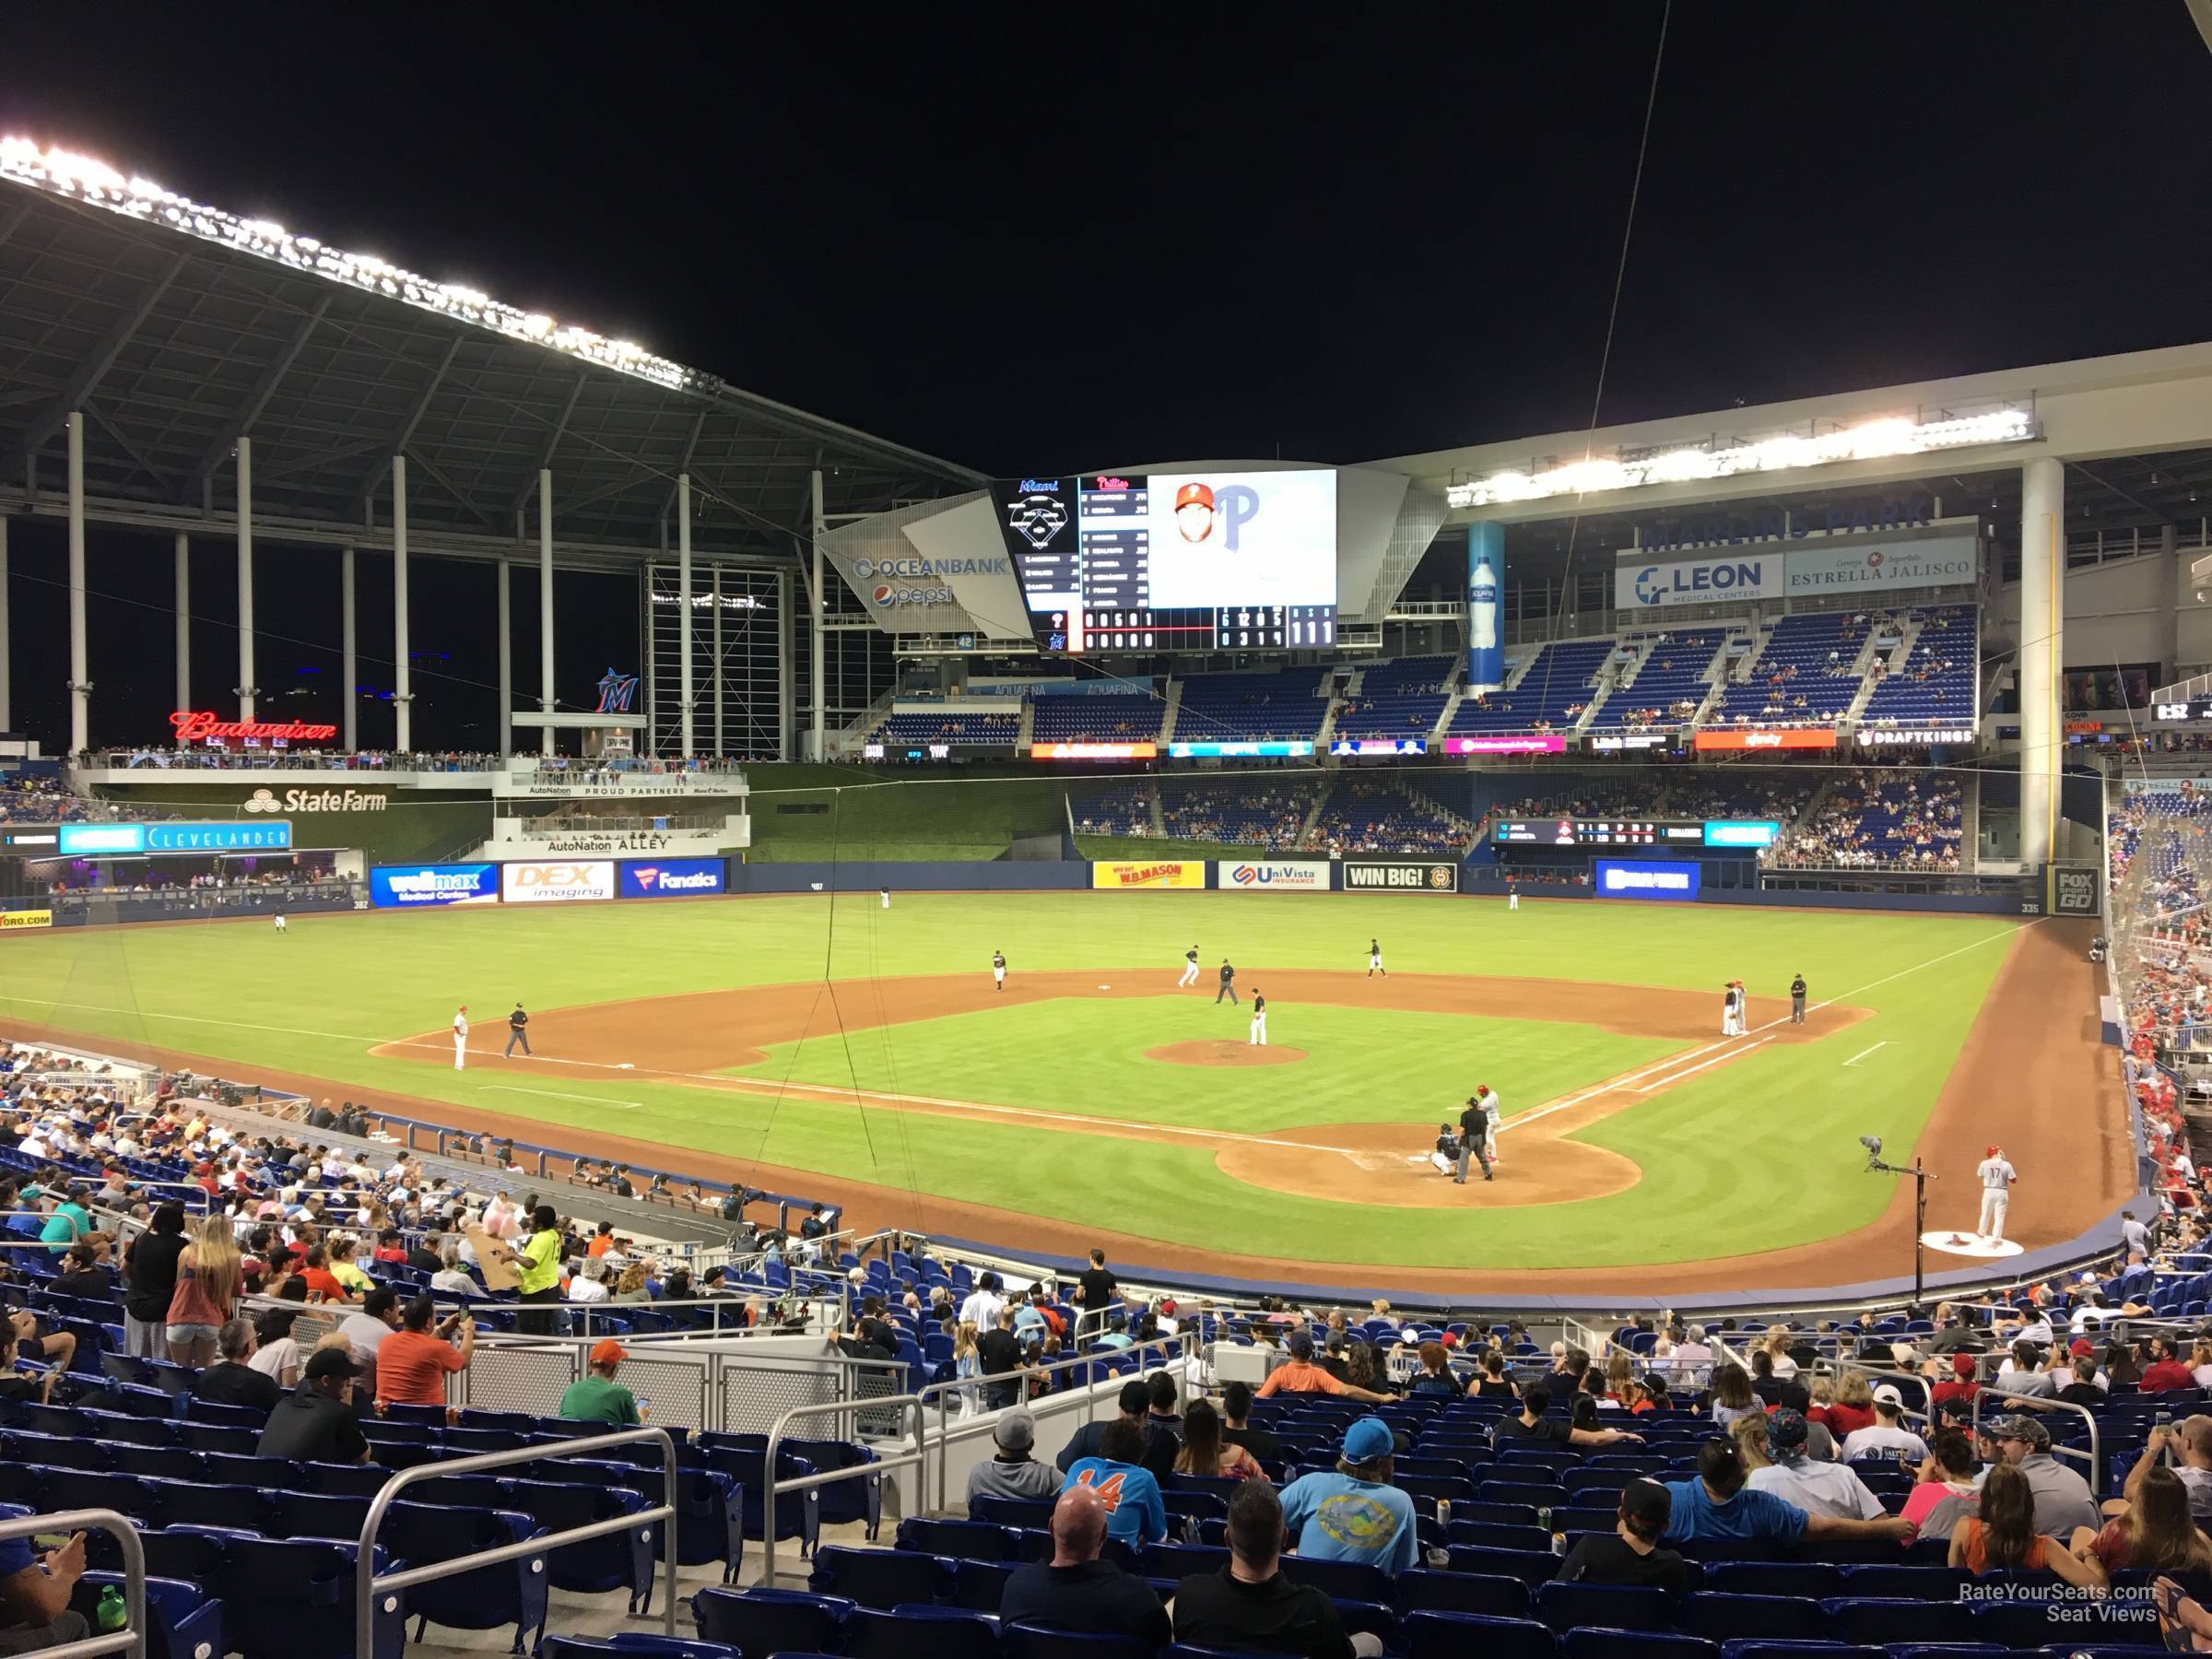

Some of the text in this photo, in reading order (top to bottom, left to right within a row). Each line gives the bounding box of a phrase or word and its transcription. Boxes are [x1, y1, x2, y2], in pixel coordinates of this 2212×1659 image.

[1826, 500, 1931, 536] PARK
[878, 558, 1007, 576] OCEANBANK
[1791, 561, 1970, 586] ESTRELLA JALISCO
[1673, 561, 1761, 593] LEON
[896, 585, 953, 605] pepsi
[1673, 590, 1761, 604] MEDICAL CENTERS
[1292, 621, 1332, 643] 1 1 1
[995, 685, 1046, 695] AQUAFNA
[169, 712, 337, 740] Budweiser
[1875, 731, 1972, 744] DRAFTKINGS
[529, 786, 571, 794] AutoNation
[147, 827, 287, 848] CLEVELANDER
[548, 839, 667, 852] AutoNation ALLEY
[515, 865, 594, 887] DEX
[659, 872, 717, 888] Fanatics
[1350, 868, 1385, 885] WIN
[1388, 868, 1423, 886] BIG!
[2059, 874, 2093, 888] FOX
[534, 888, 604, 899] imaging
[2060, 894, 2092, 908] GO
[2021, 904, 2040, 913] 335
[1991, 1167, 2001, 1179] 17
